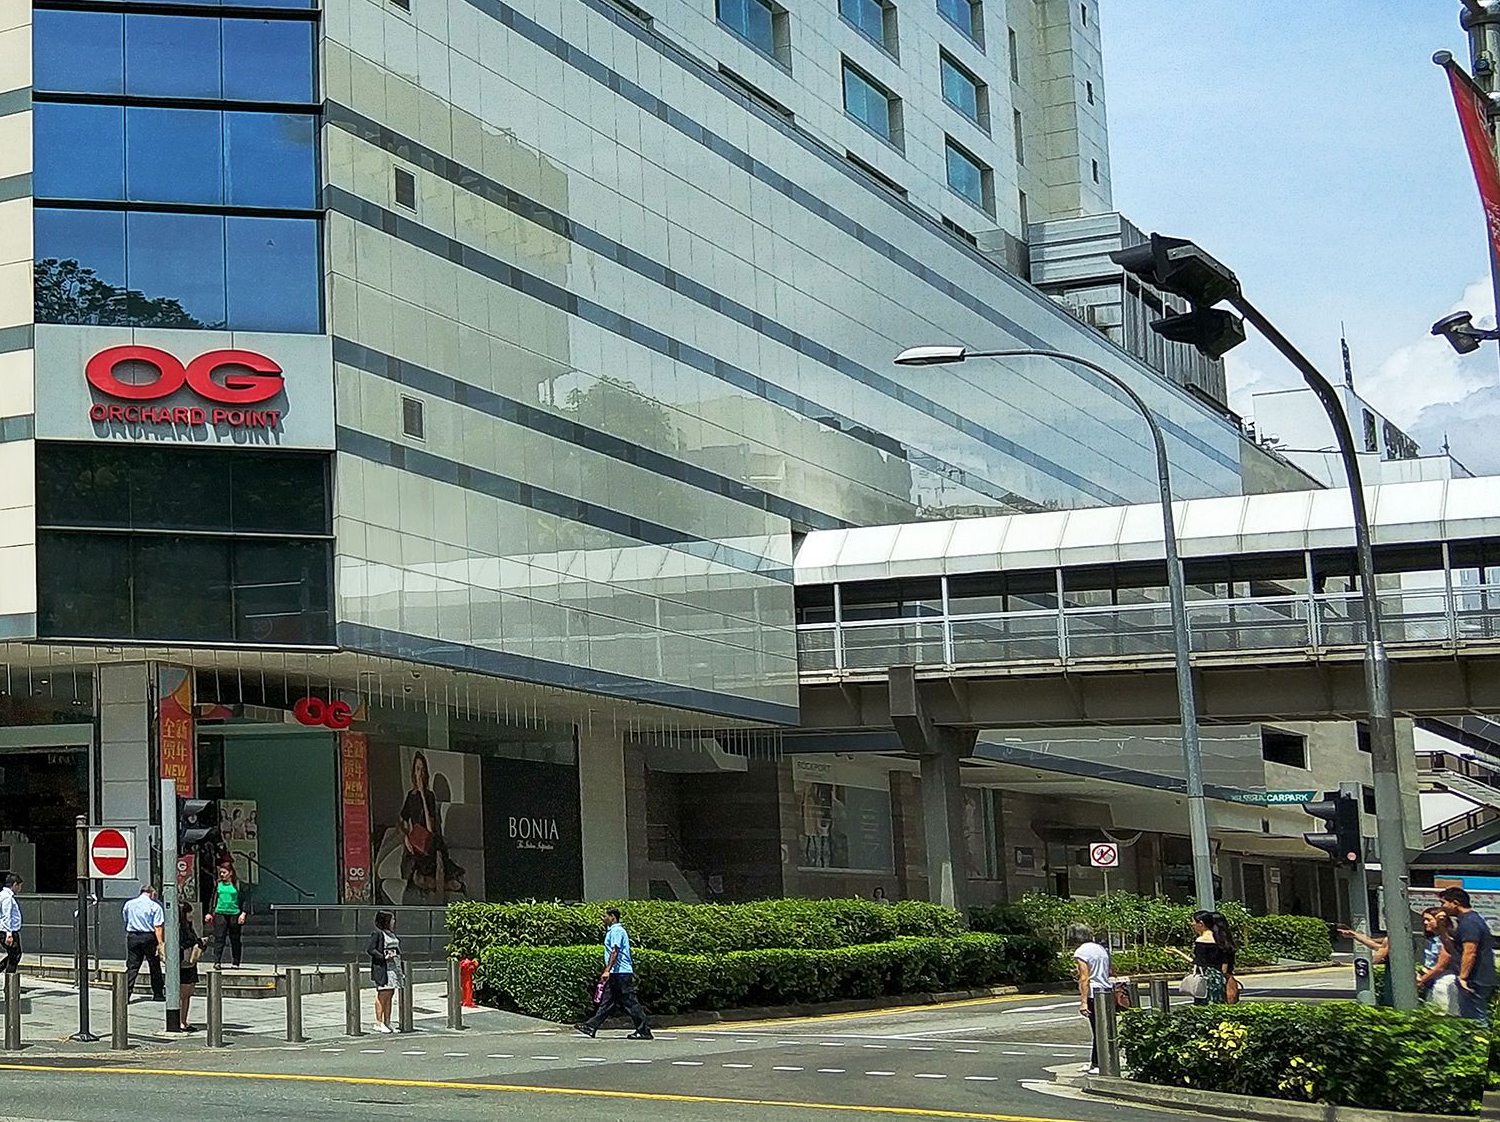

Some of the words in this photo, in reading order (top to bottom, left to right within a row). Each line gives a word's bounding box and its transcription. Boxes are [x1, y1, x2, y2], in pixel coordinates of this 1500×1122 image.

[85, 345, 286, 403] OG
[90, 404, 207, 426] ORCHARD
[212, 408, 282, 429] POINT
[293, 697, 352, 729] OG
[164, 764, 187, 777] NEW
[345, 781, 364, 792] NEW
[1266, 793, 1309, 803] CARPARK
[508, 816, 559, 840] BONIA
[349, 867, 365, 877] OG
